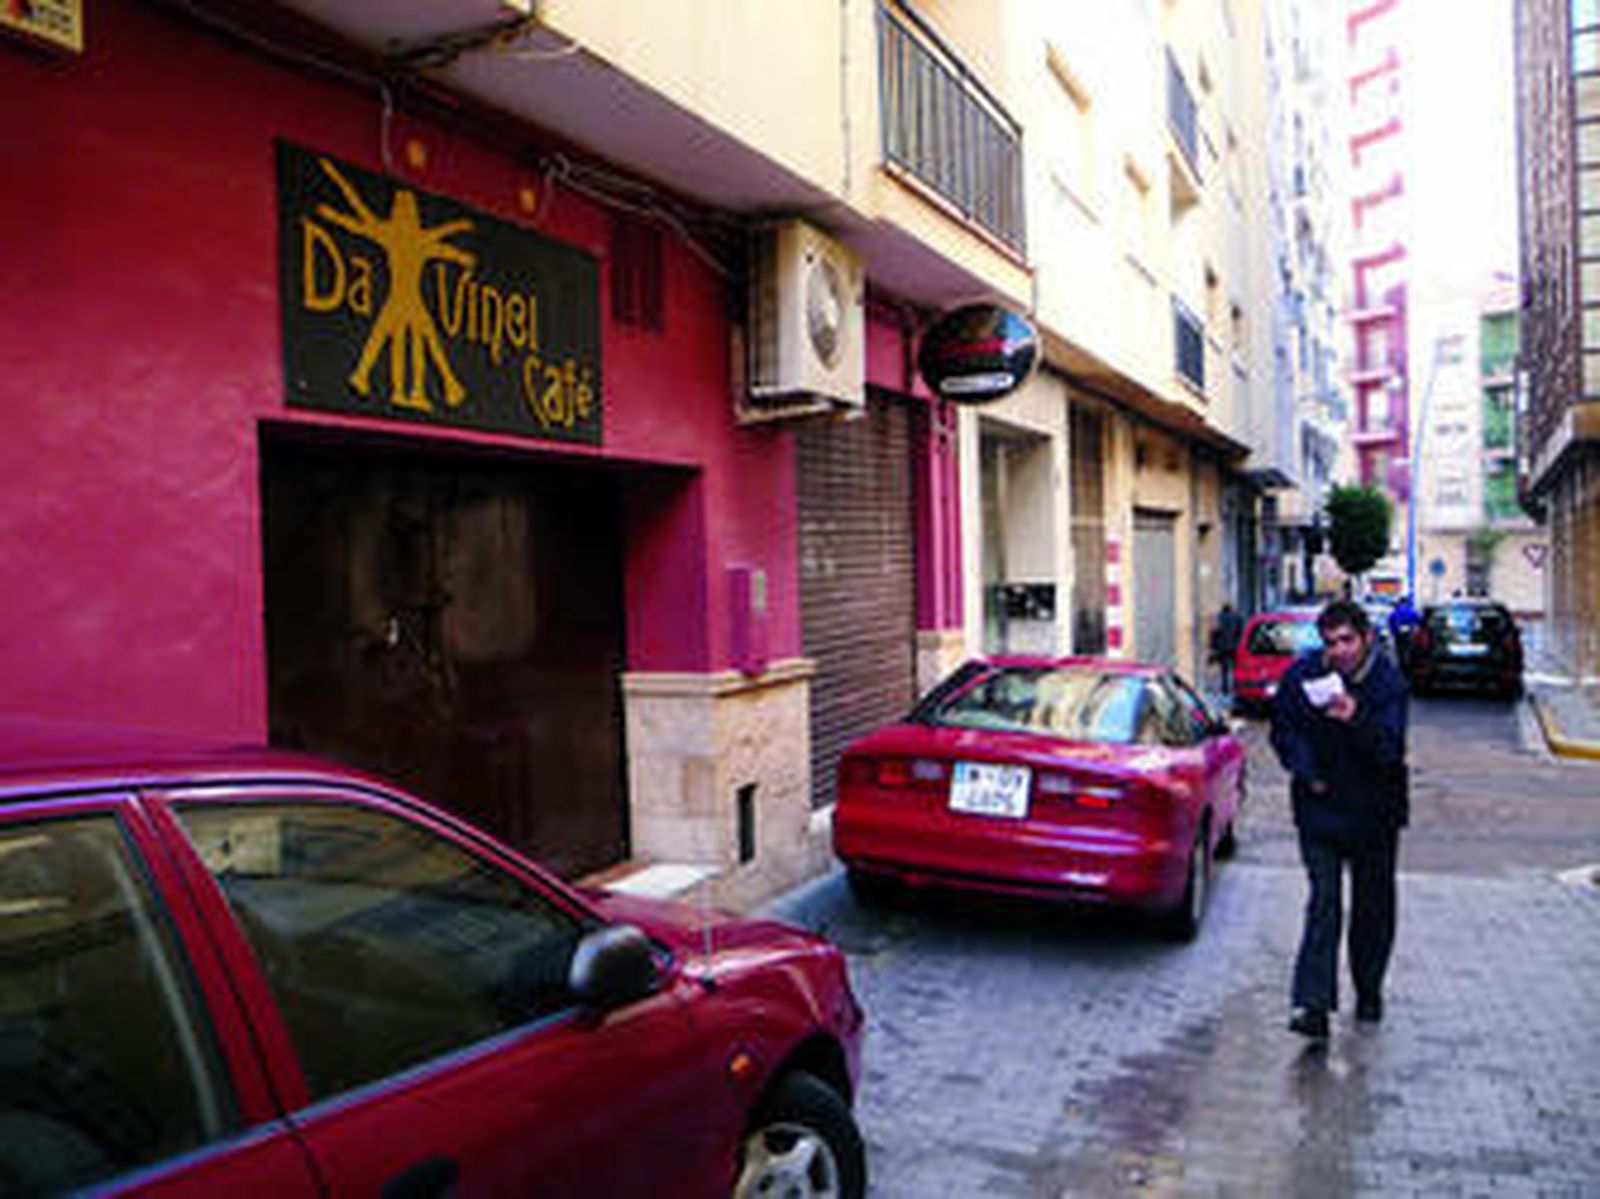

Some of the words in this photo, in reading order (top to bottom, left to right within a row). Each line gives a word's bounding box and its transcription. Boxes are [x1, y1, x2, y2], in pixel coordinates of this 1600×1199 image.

[303, 217, 372, 315] Da
[437, 263, 538, 366] Vinci
[523, 354, 593, 431] Café
